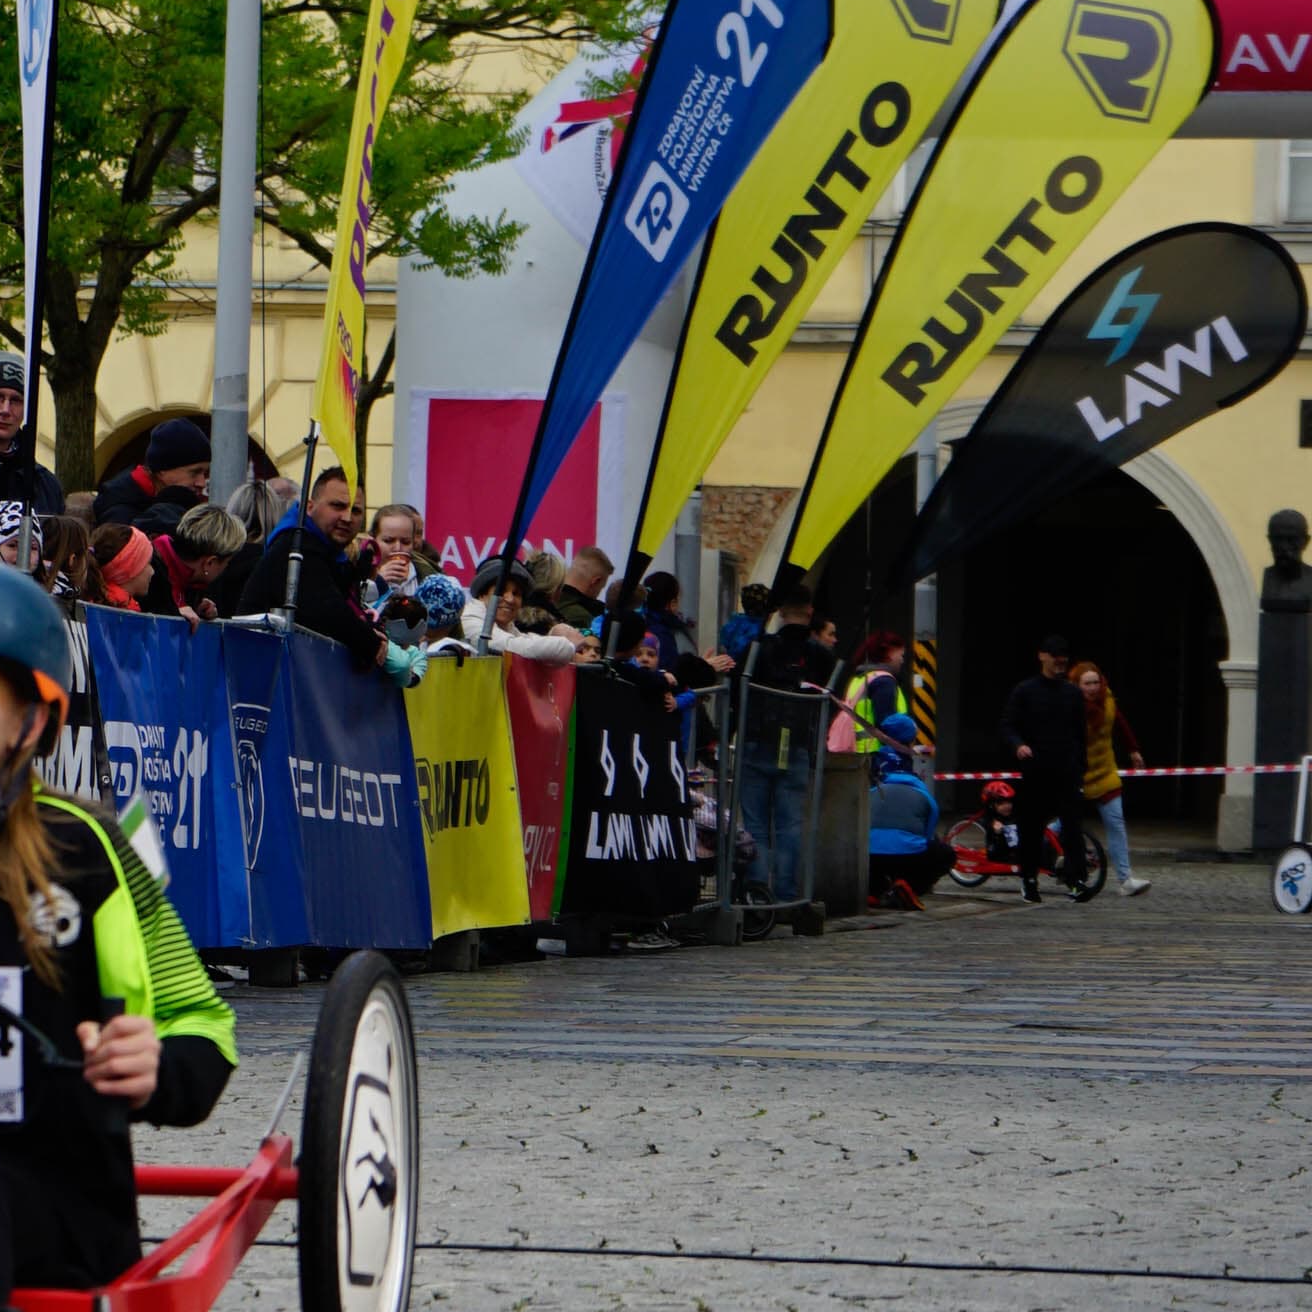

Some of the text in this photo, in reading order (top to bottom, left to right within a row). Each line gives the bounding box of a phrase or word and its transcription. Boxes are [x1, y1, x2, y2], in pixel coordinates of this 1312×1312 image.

[656, 64, 706, 159] ZDRAVOTNÍ
[678, 75, 737, 184] MINISTERSTVA
[688, 111, 734, 192] VNITRA ČR
[714, 80, 912, 368] RUNTO
[880, 154, 1104, 408] RUNTO
[1075, 315, 1249, 442] LAWI
